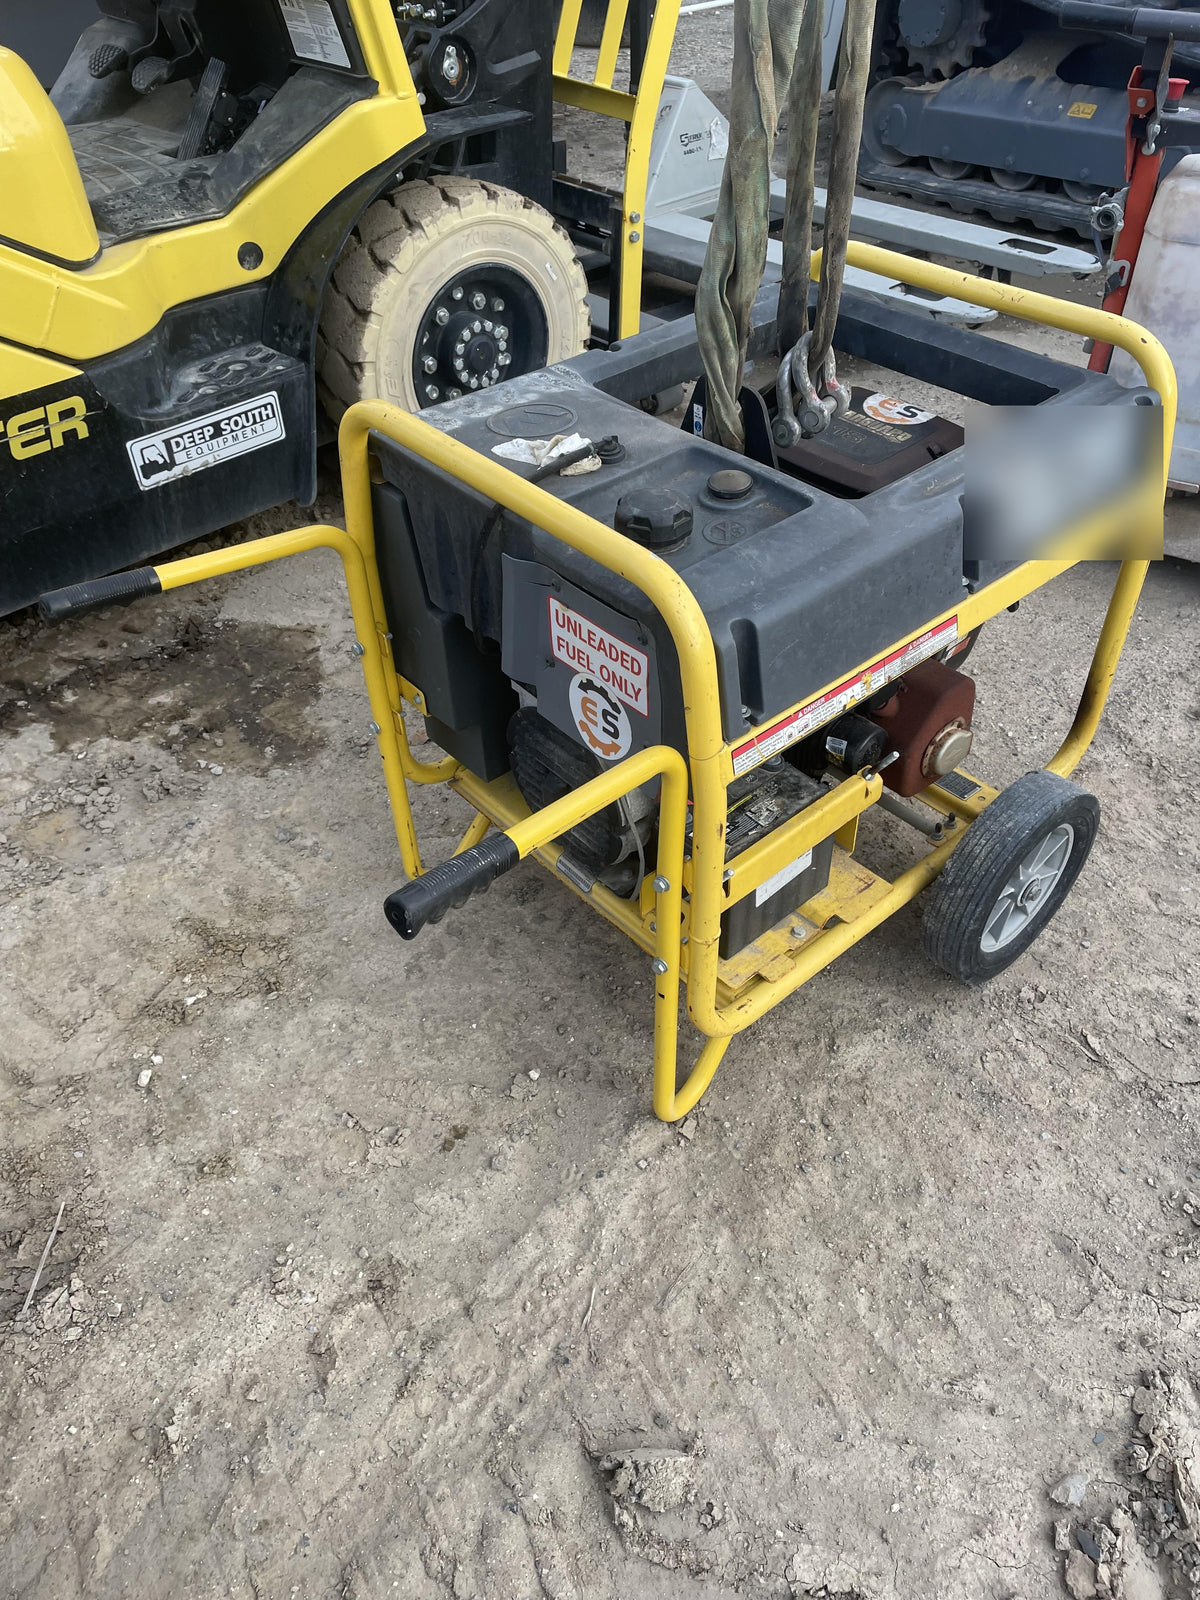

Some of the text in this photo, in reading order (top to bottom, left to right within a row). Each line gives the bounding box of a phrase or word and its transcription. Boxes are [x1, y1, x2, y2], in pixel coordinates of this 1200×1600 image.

[0, 395, 90, 461] ER
[170, 405, 274, 453] DEEP SOUTH
[186, 424, 266, 460] EQUIPMENT
[555, 608, 641, 676] UNLEADED
[556, 636, 642, 702] FUEL ONLY
[581, 696, 620, 740] ES
[803, 697, 826, 715] DANGER
